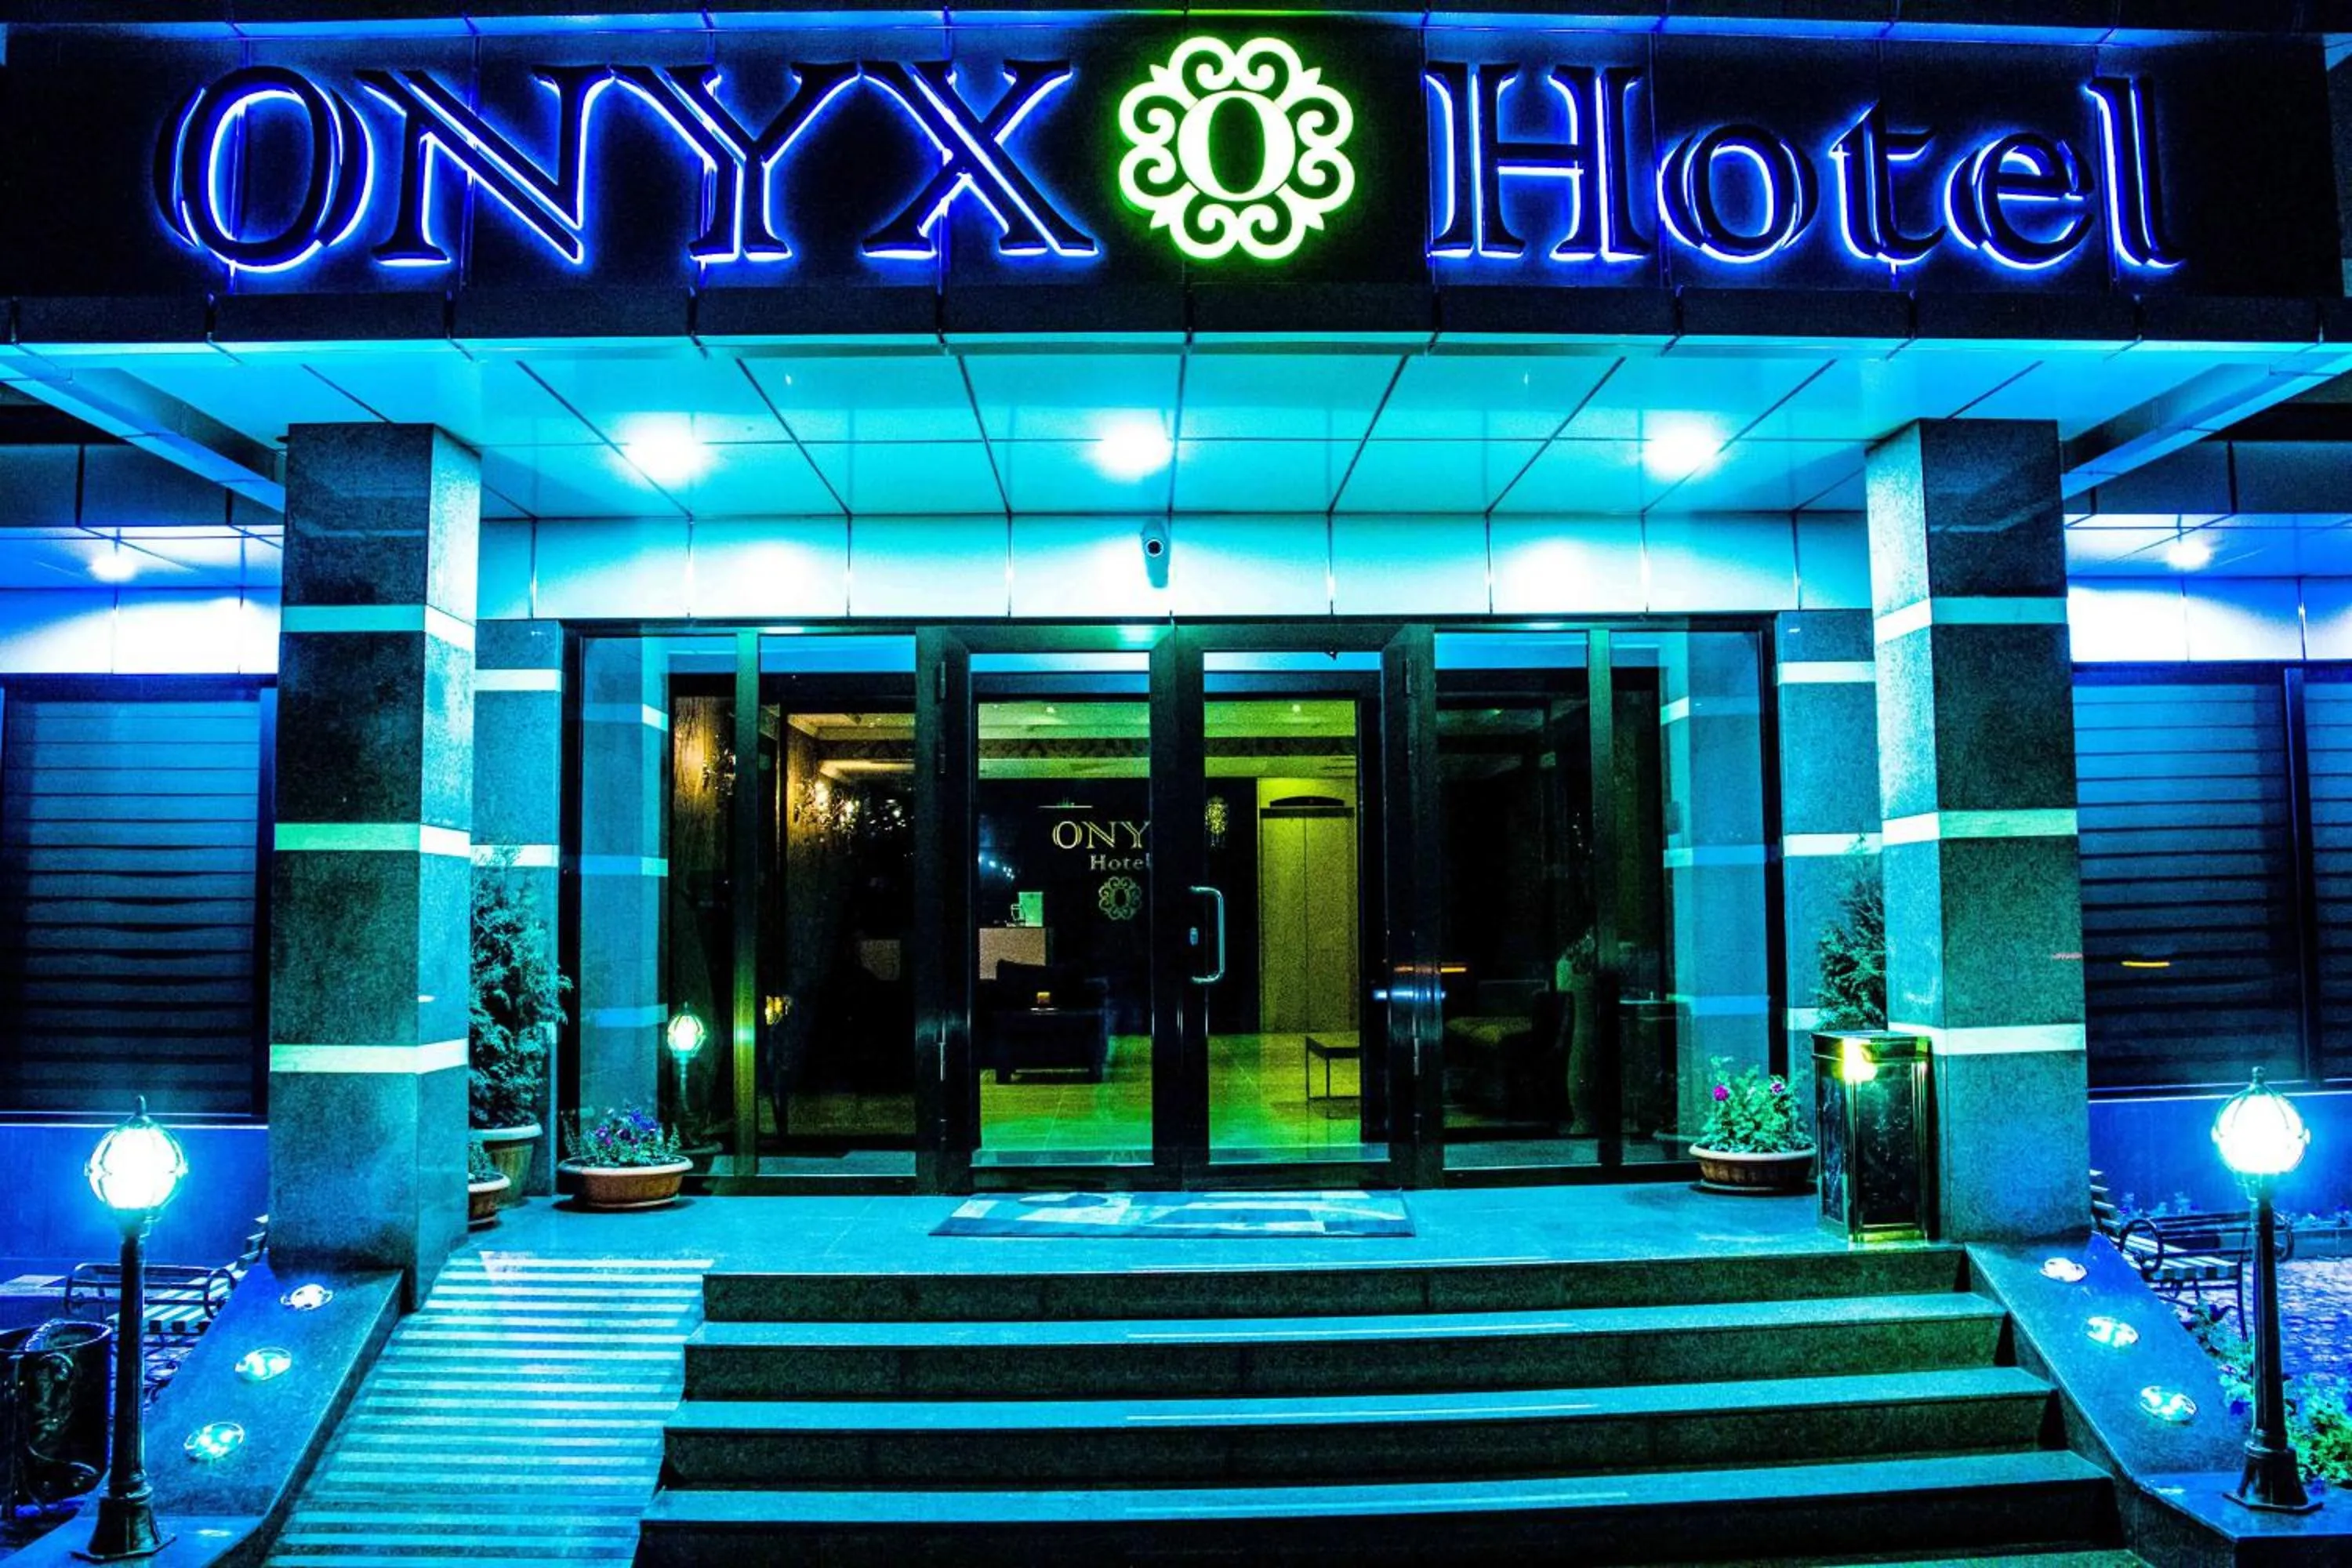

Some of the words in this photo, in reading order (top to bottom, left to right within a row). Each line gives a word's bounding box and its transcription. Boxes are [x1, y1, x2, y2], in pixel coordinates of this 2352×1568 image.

[153, 63, 1099, 273] ONYX
[1423, 60, 2187, 270] Hotel
[1052, 820, 1151, 849] ONY
